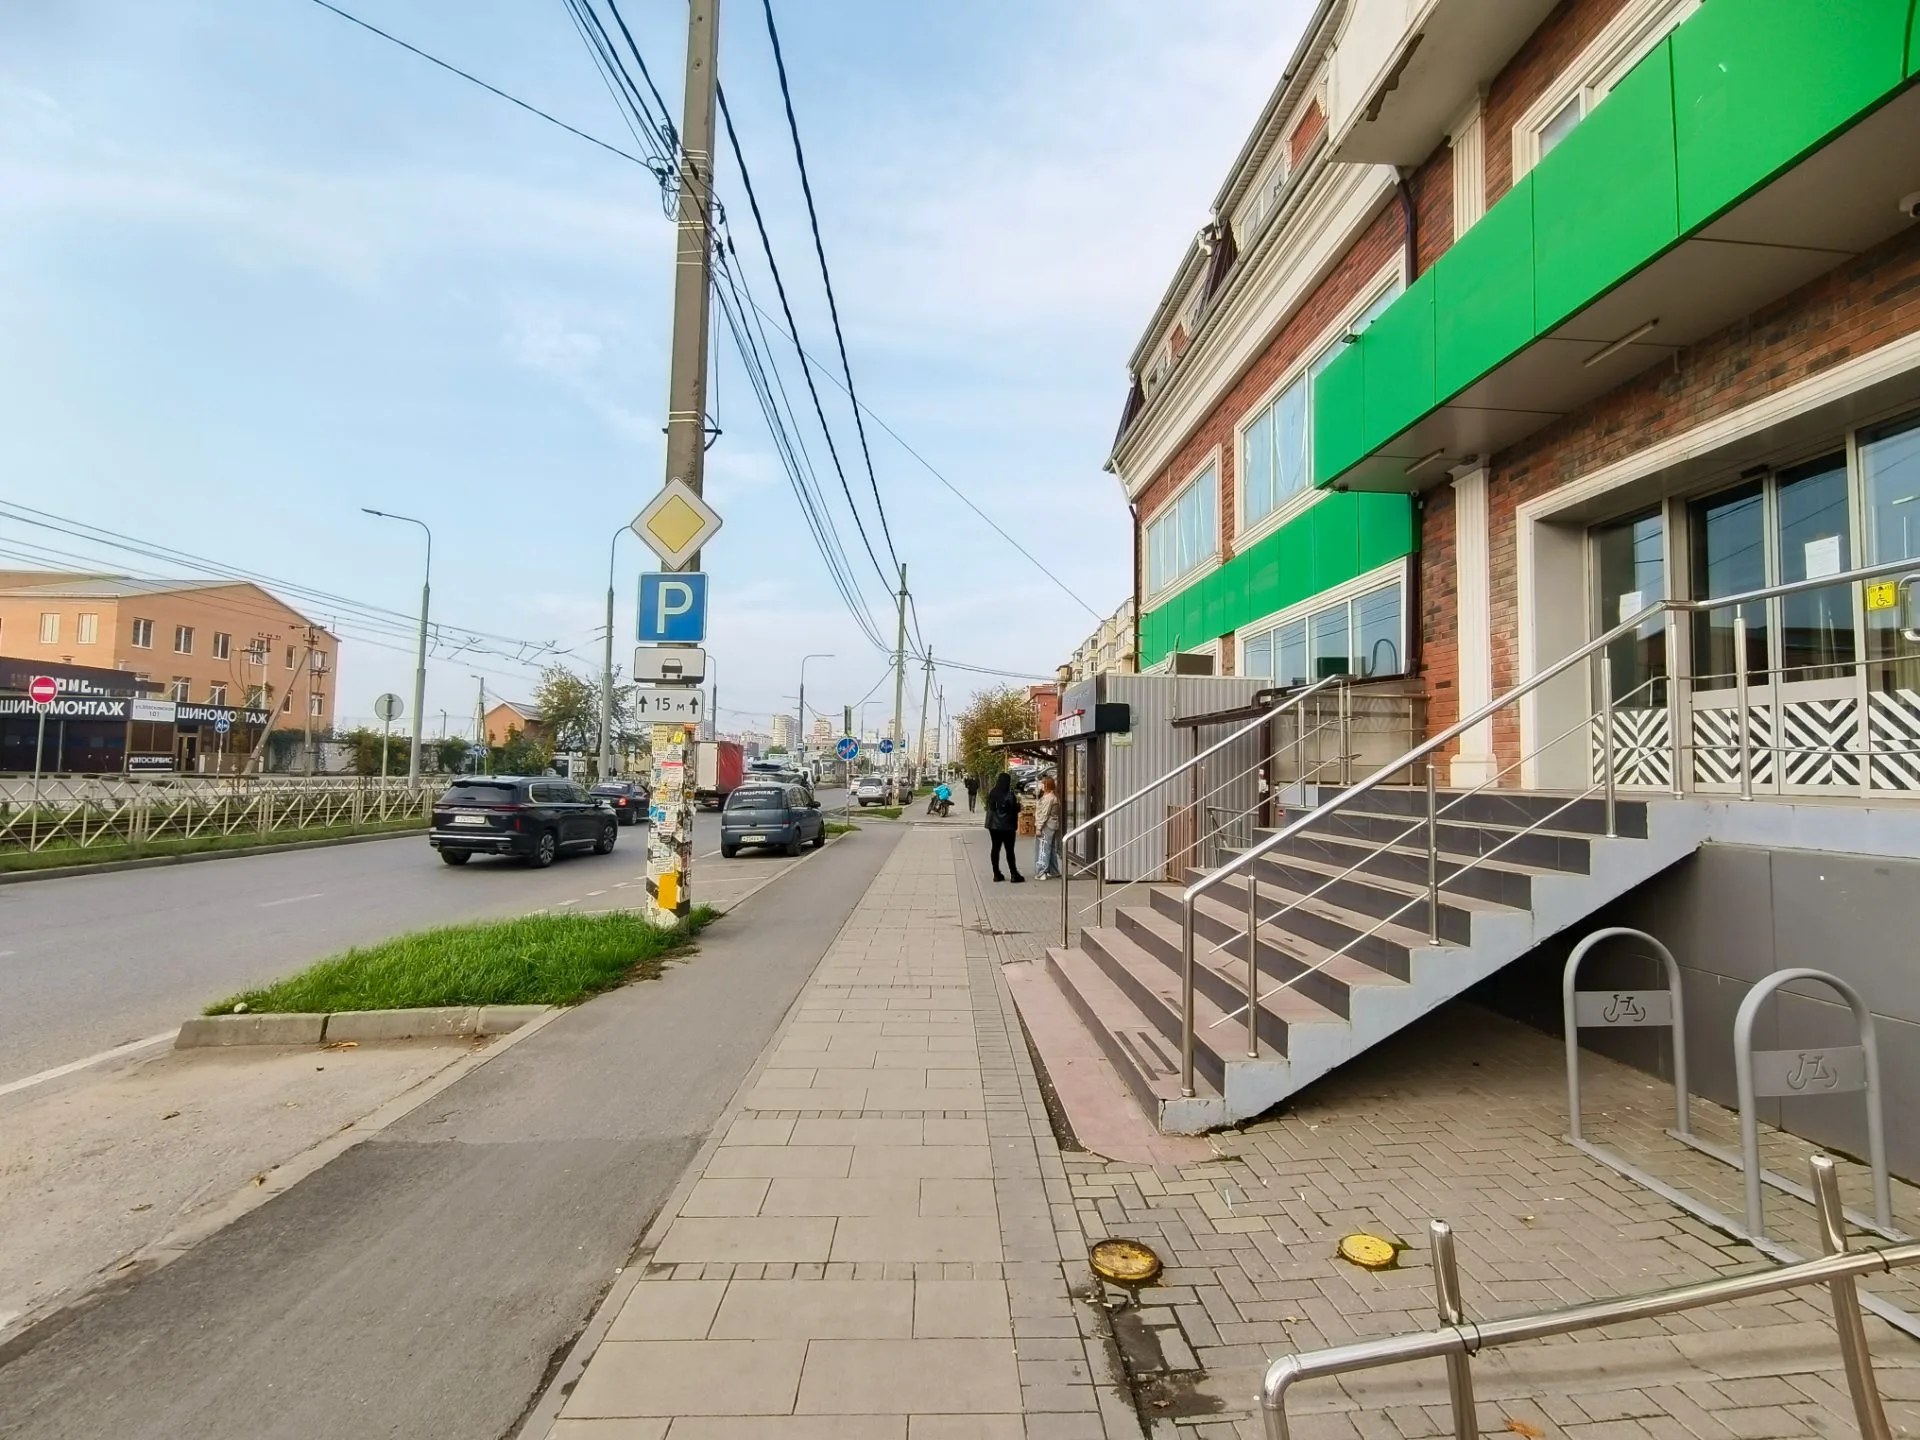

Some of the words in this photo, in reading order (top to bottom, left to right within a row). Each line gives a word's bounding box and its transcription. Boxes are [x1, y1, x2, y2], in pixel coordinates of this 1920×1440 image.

[656, 582, 694, 634] P
[0, 700, 124, 716] ШИНОМОНТАЖ
[655, 698, 671, 712] 15
[177, 707, 267, 724] ШИНОМОТАЖ
